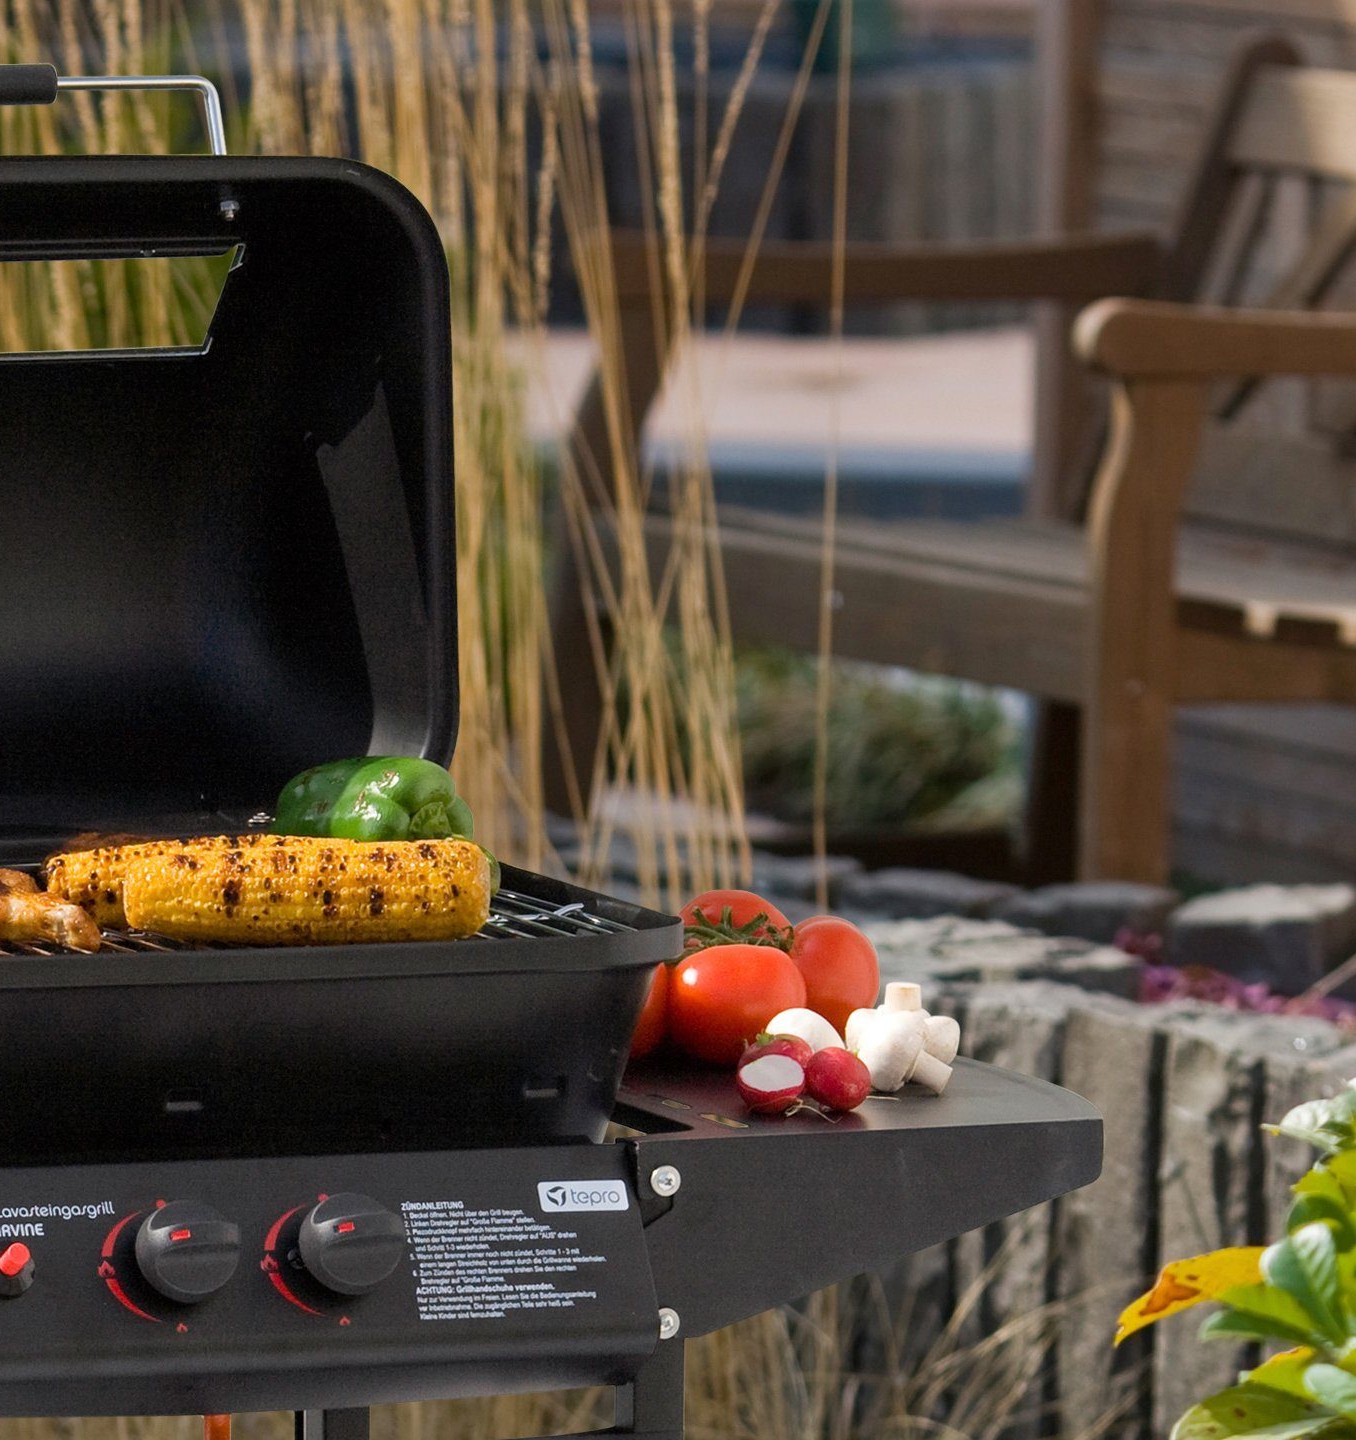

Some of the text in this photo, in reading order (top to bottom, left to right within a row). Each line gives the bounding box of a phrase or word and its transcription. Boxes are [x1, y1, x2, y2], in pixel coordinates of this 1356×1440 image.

[571, 1189, 620, 1206] tepro
[401, 1201, 464, 1210] ZÜNDANLEITUNG
[416, 1286, 455, 1294] ACHTUNG:
